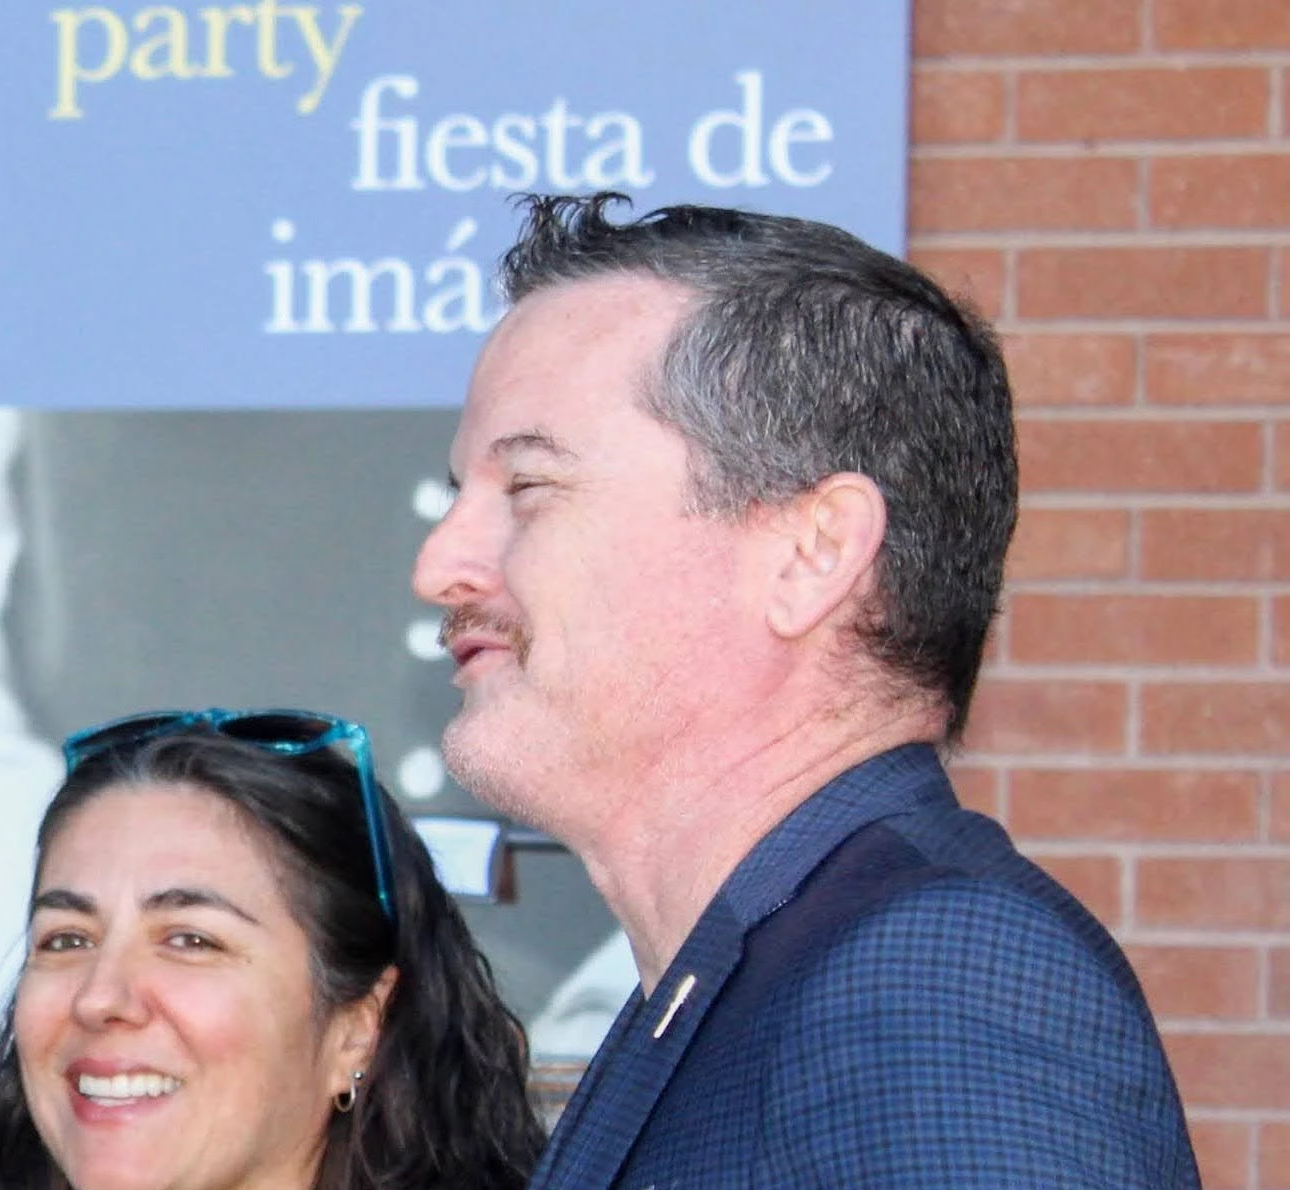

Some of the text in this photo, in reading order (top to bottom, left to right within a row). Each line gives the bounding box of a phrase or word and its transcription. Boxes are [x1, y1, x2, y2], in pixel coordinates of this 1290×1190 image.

[50, 0, 362, 118] party
[350, 70, 834, 193] fiesta de
[263, 219, 497, 336] imá
